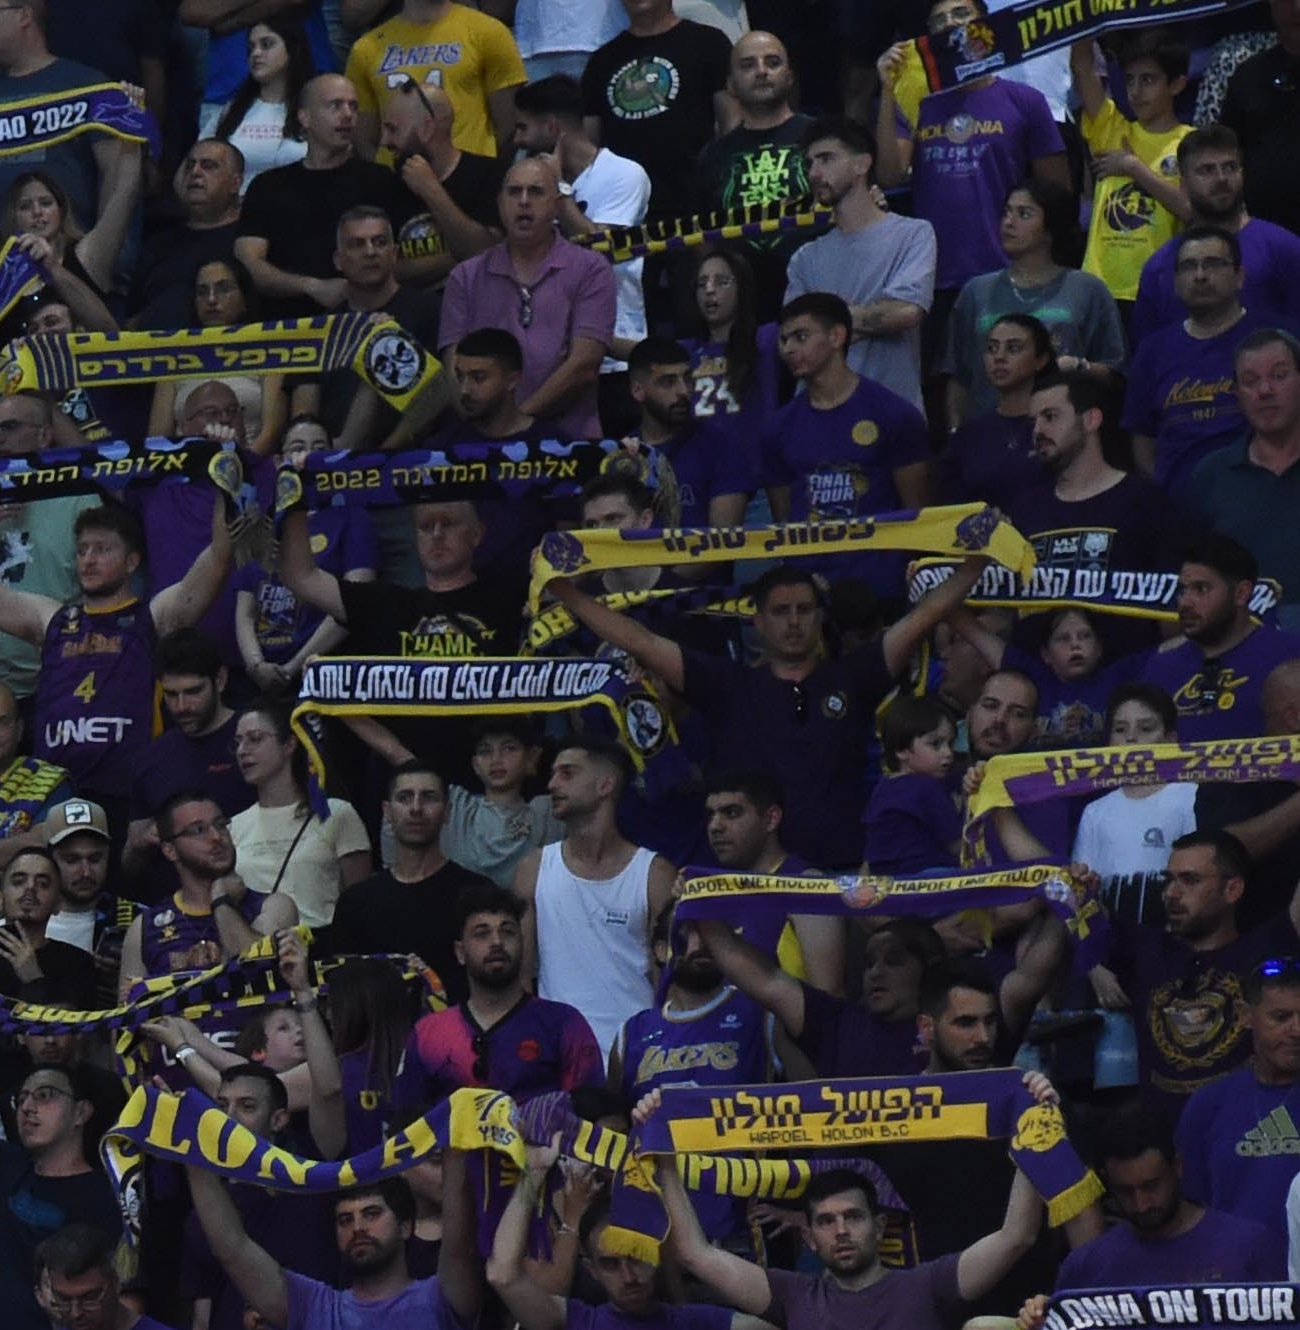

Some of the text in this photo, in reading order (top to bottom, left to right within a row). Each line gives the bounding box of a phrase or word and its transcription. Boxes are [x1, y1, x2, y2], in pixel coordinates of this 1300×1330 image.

[378, 41, 462, 75] LAKERS
[32, 101, 89, 134] 2022
[694, 379, 740, 417] 24
[92, 451, 189, 479] אלופת
[315, 458, 579, 492] אלופת המדינה 2022
[807, 473, 854, 490] FINAL
[812, 488, 855, 504] FOUR
[1074, 568, 1107, 599] עם
[73, 671, 97, 704] 4
[45, 717, 133, 748] UNET
[637, 1041, 740, 1079] LAKERS
[710, 1085, 944, 1136] הפועל חולון
[748, 1124, 910, 1145] HAPOEL HOLON B.C
[1147, 1288, 1199, 1324] ON
[1202, 1287, 1295, 1323] TOUR
